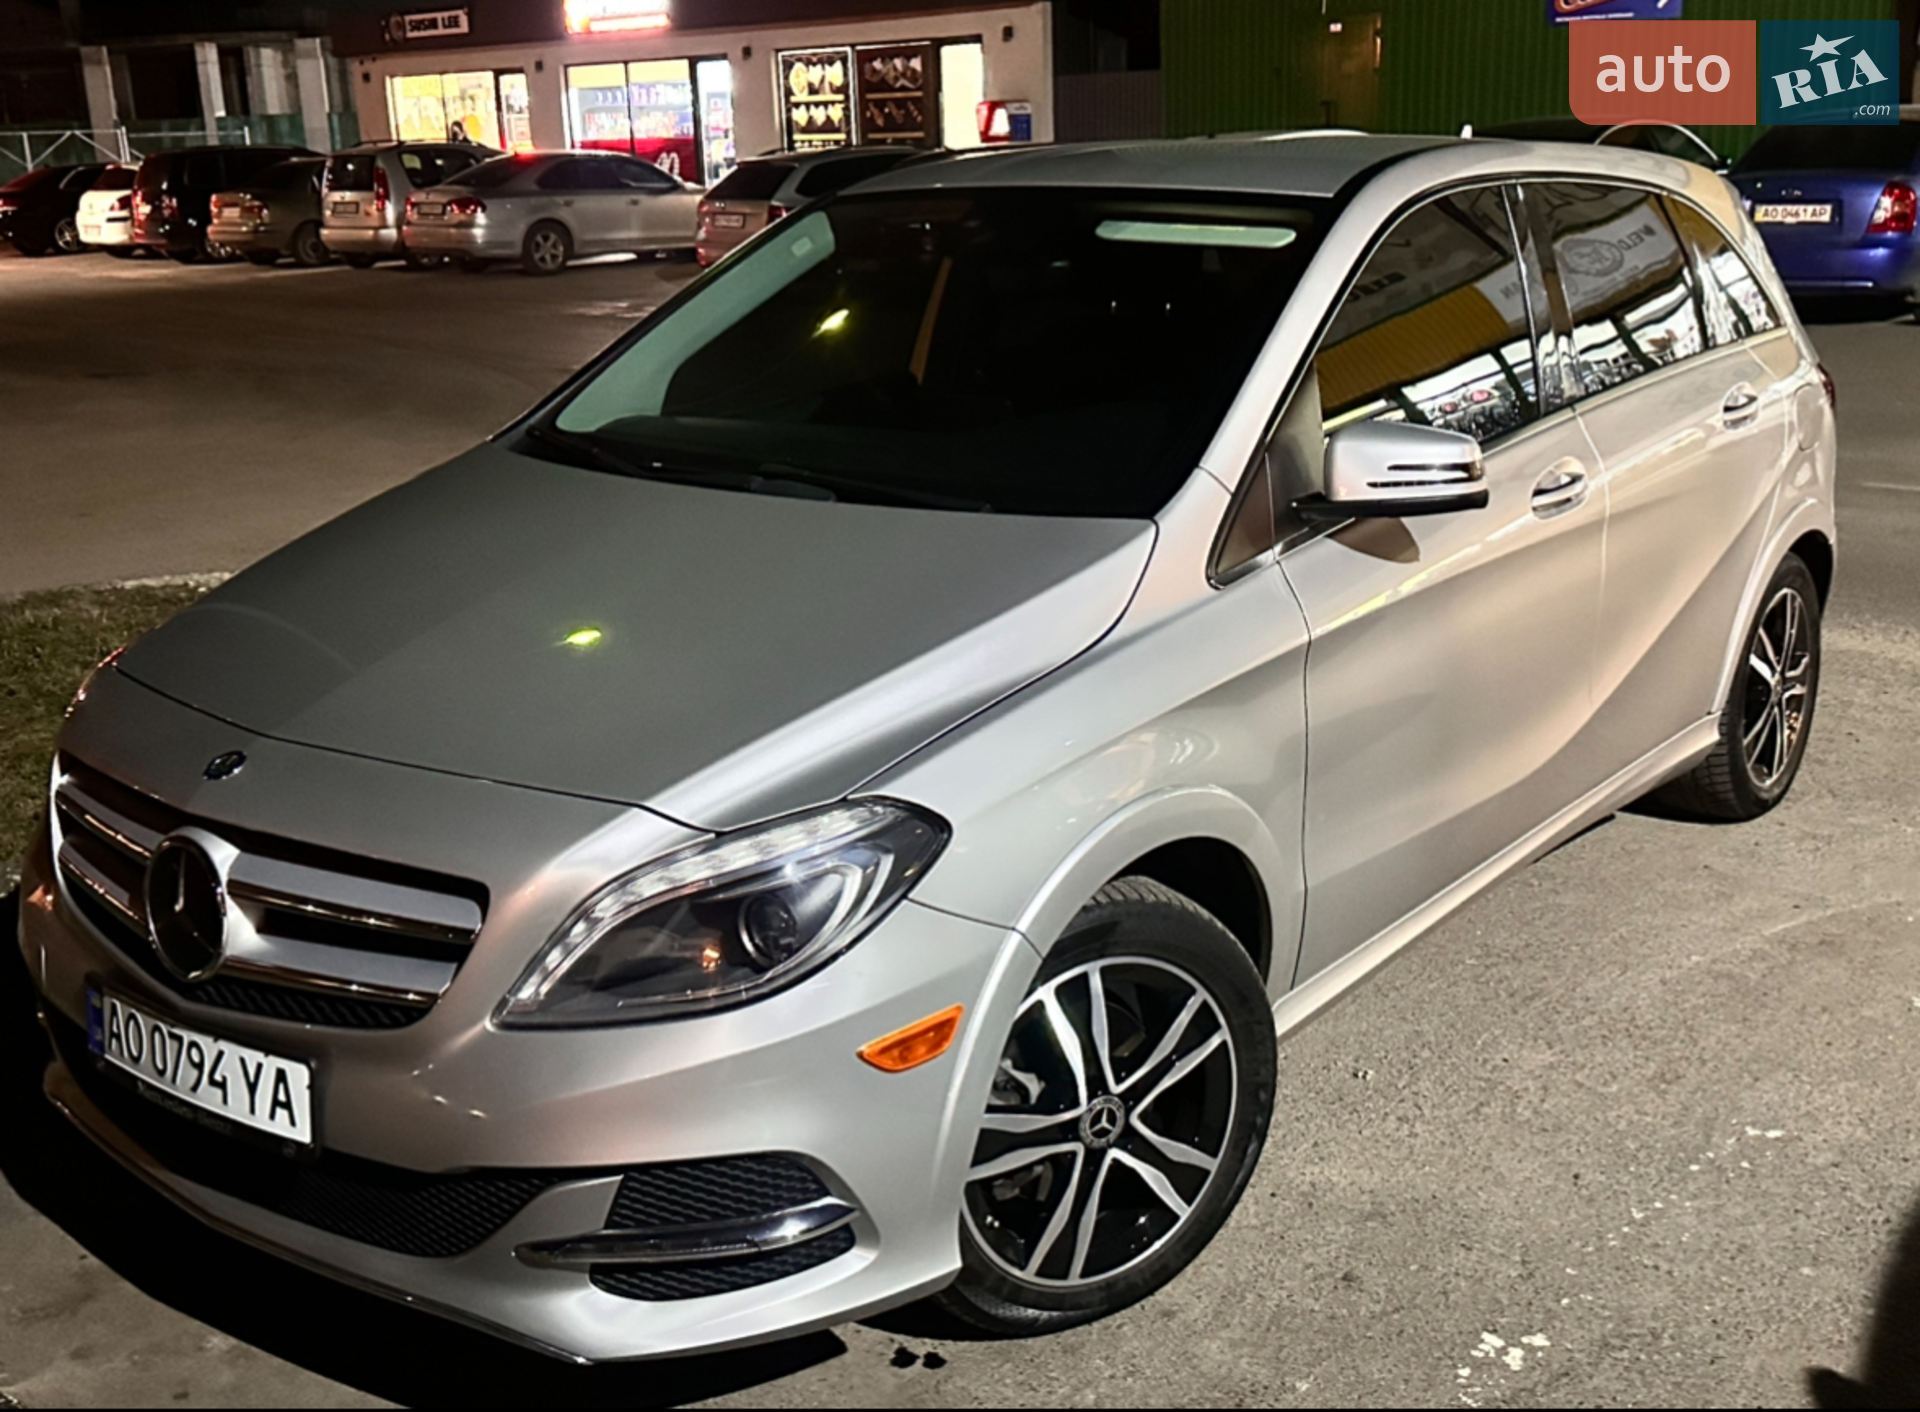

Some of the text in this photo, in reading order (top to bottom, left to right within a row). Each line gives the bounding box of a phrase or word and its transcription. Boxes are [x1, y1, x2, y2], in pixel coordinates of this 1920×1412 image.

[408, 14, 461, 32] SUSHI LEE
[108, 1001, 297, 1128] AO 0794 YA
